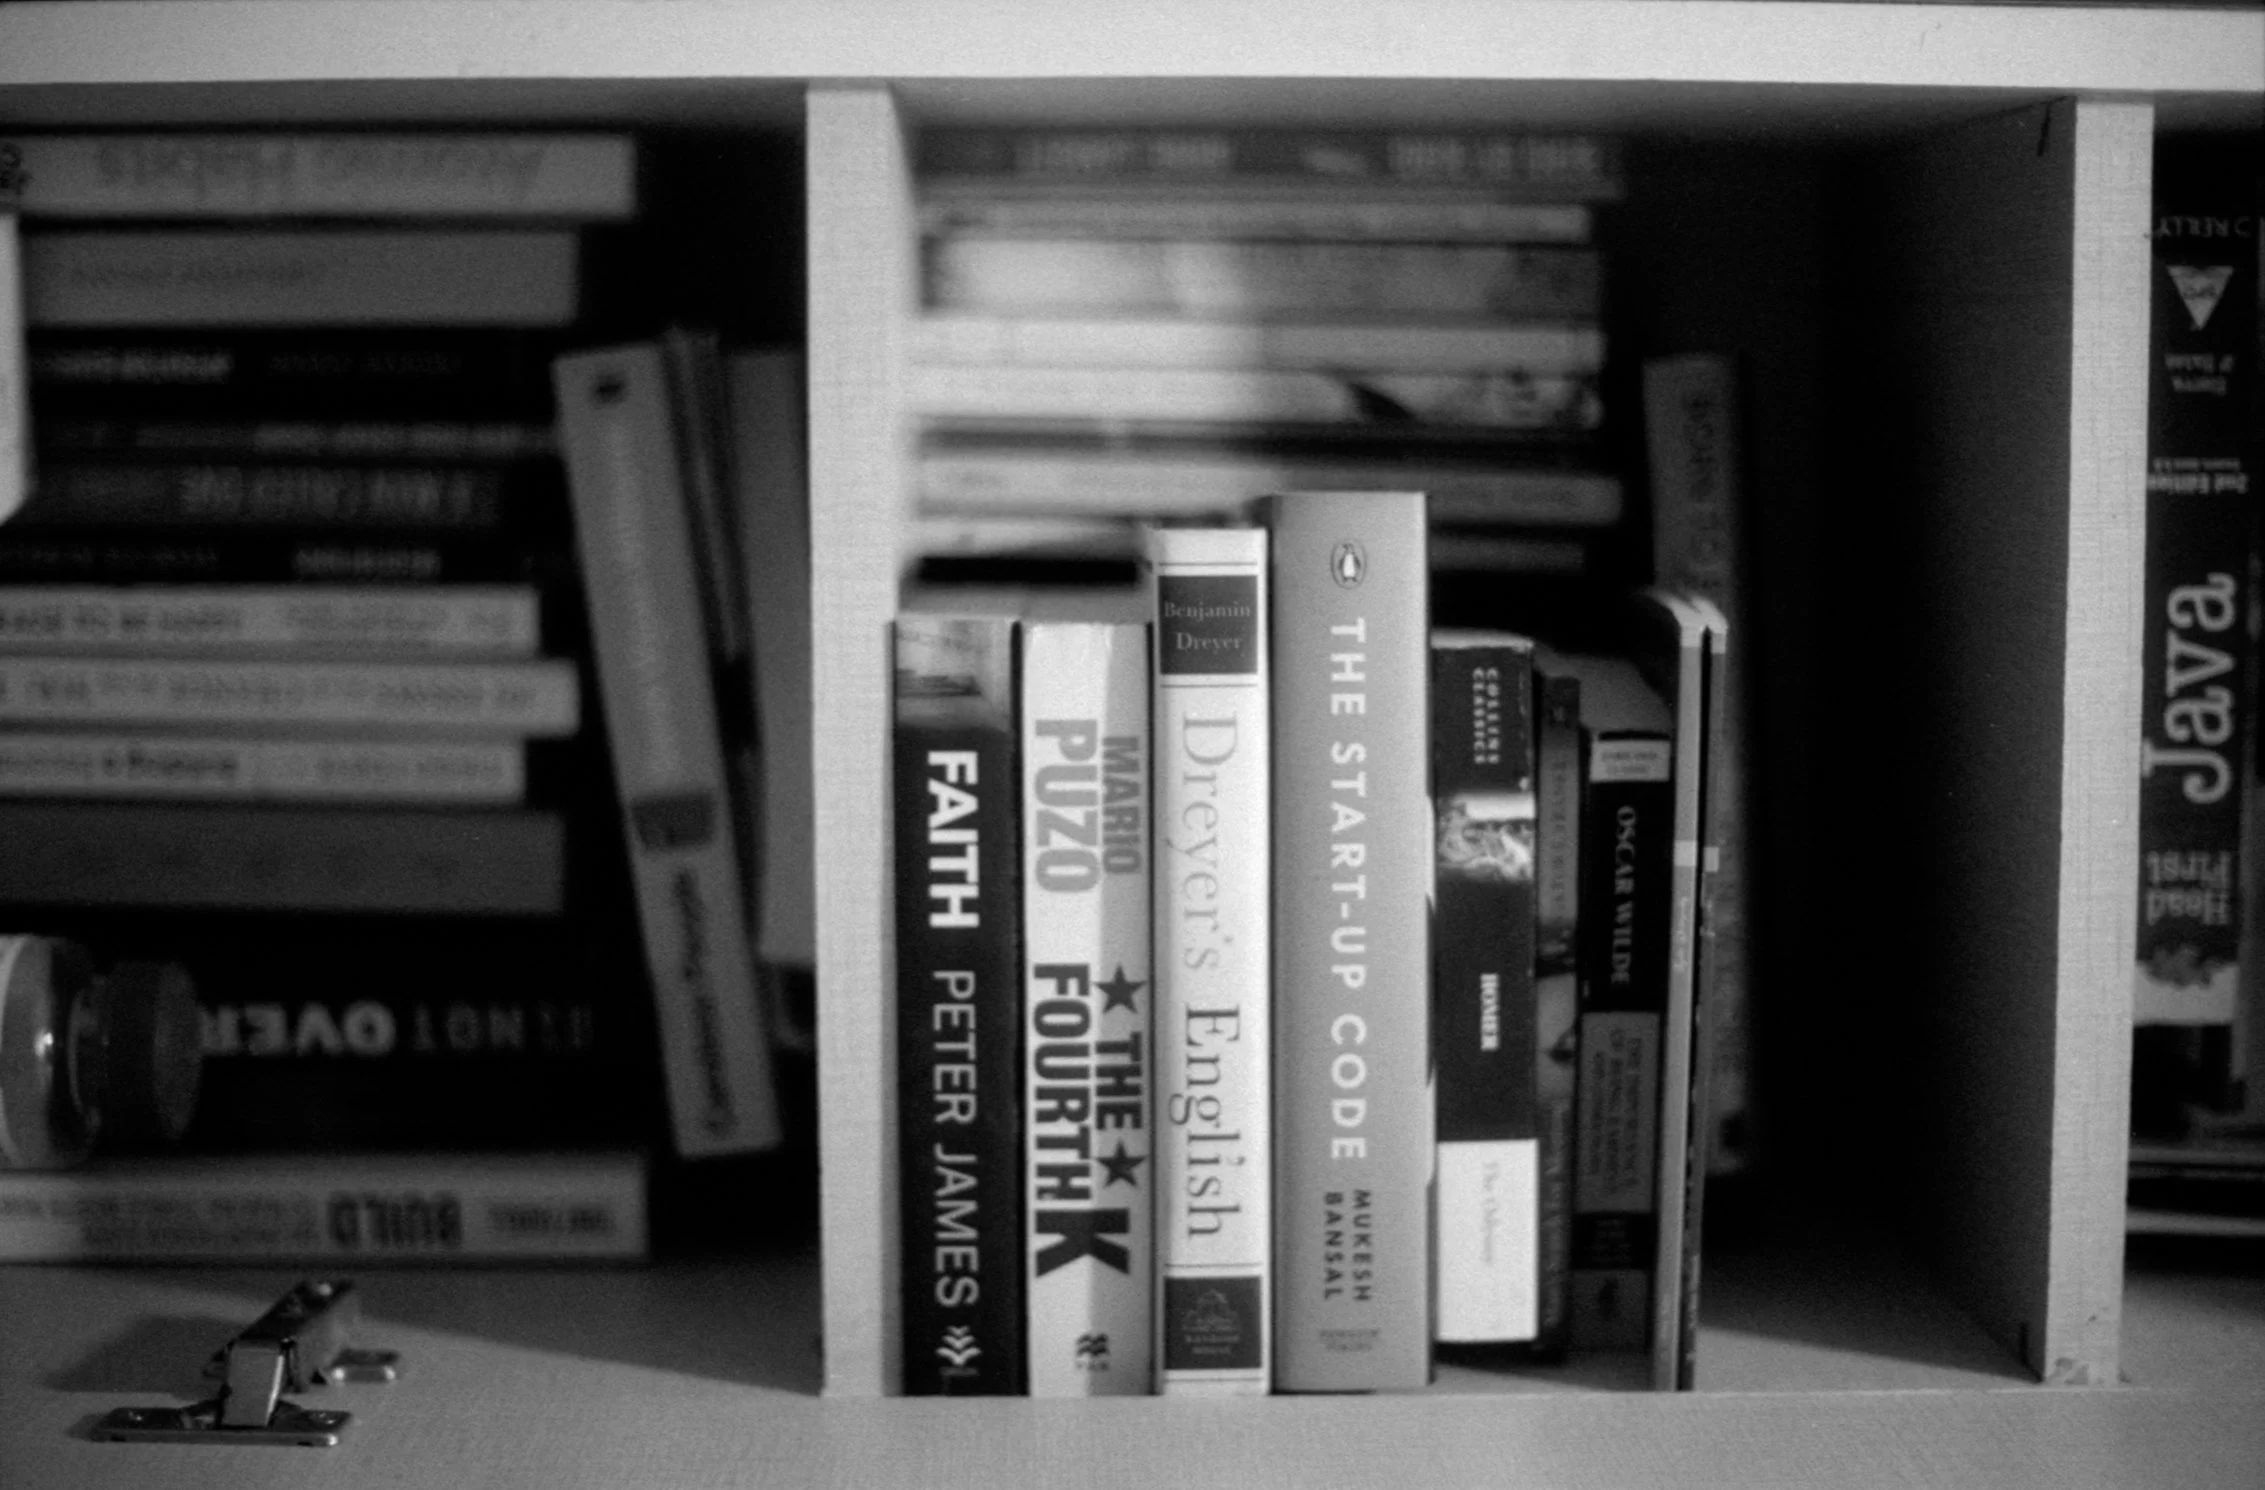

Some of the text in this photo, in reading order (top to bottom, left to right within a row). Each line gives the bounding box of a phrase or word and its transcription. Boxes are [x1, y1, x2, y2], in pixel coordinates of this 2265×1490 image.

[2154, 215, 2253, 239] OREILLY
[1163, 601, 1252, 622] Benjamin
[1175, 632, 1243, 653] Dreyer
[1472, 666, 1486, 765] CLASSICS
[1486, 666, 1500, 765] COLLINS
[2142, 571, 2238, 805] Java
[927, 750, 980, 928] FAITH
[1034, 718, 1099, 893] PUZO
[1102, 736, 1141, 875] MARIO
[1166, 711, 1240, 970] Dreyer's
[1329, 616, 1368, 1160] THE START-UP CODE
[1610, 805, 1637, 985] OSCAR WILDE
[1480, 972, 1499, 1052] HOMER
[932, 970, 979, 1308] PETER JAMES
[1033, 963, 1092, 1202] FOURTH
[1095, 1030, 1142, 1131] THE
[1168, 1003, 1246, 1240] English
[1033, 1207, 1130, 1279] K
[1323, 1190, 1345, 1301] BANSAL
[1352, 1188, 1373, 1302] MUKESH
